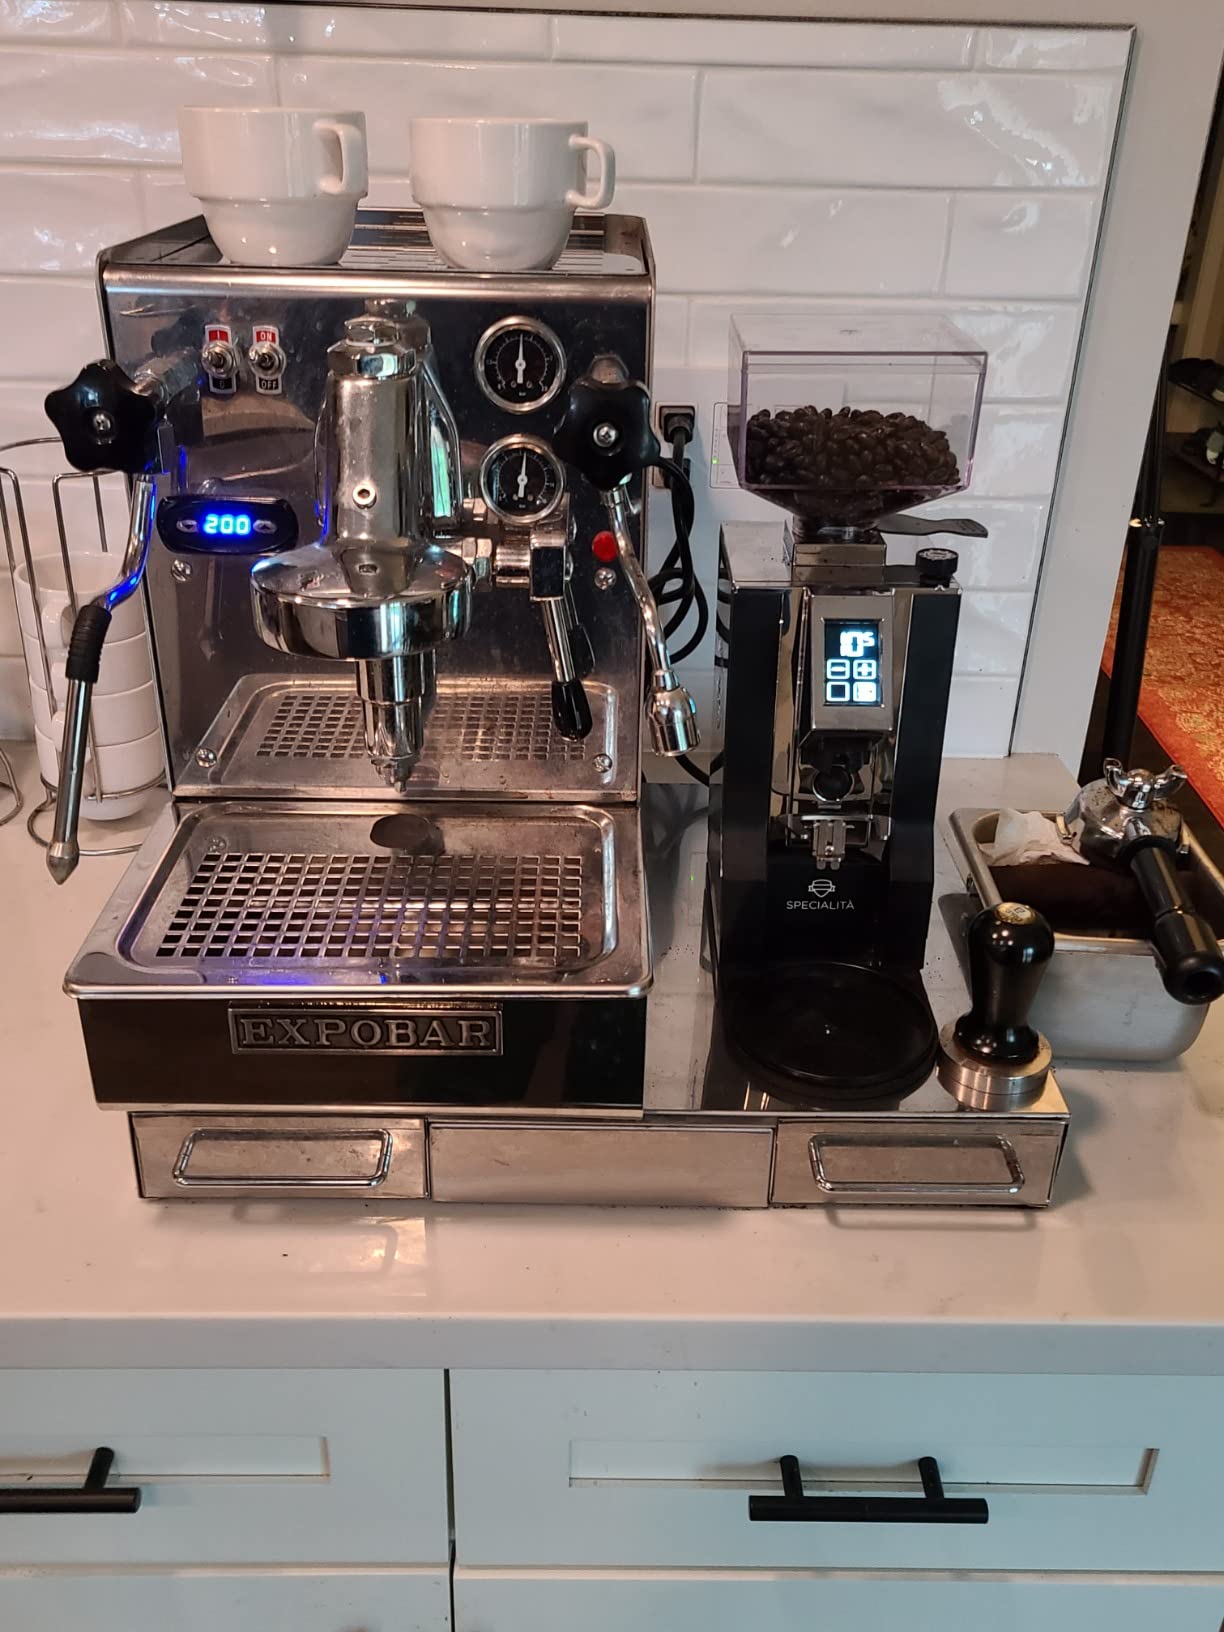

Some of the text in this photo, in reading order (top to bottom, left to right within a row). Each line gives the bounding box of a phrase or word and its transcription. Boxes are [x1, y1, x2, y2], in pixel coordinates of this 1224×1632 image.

[260, 331, 273, 341] ON
[261, 381, 277, 389] OFF
[203, 513, 251, 535] 200
[786, 899, 855, 910] SPECIALITÀ
[239, 1017, 491, 1047] EXPOBAR
